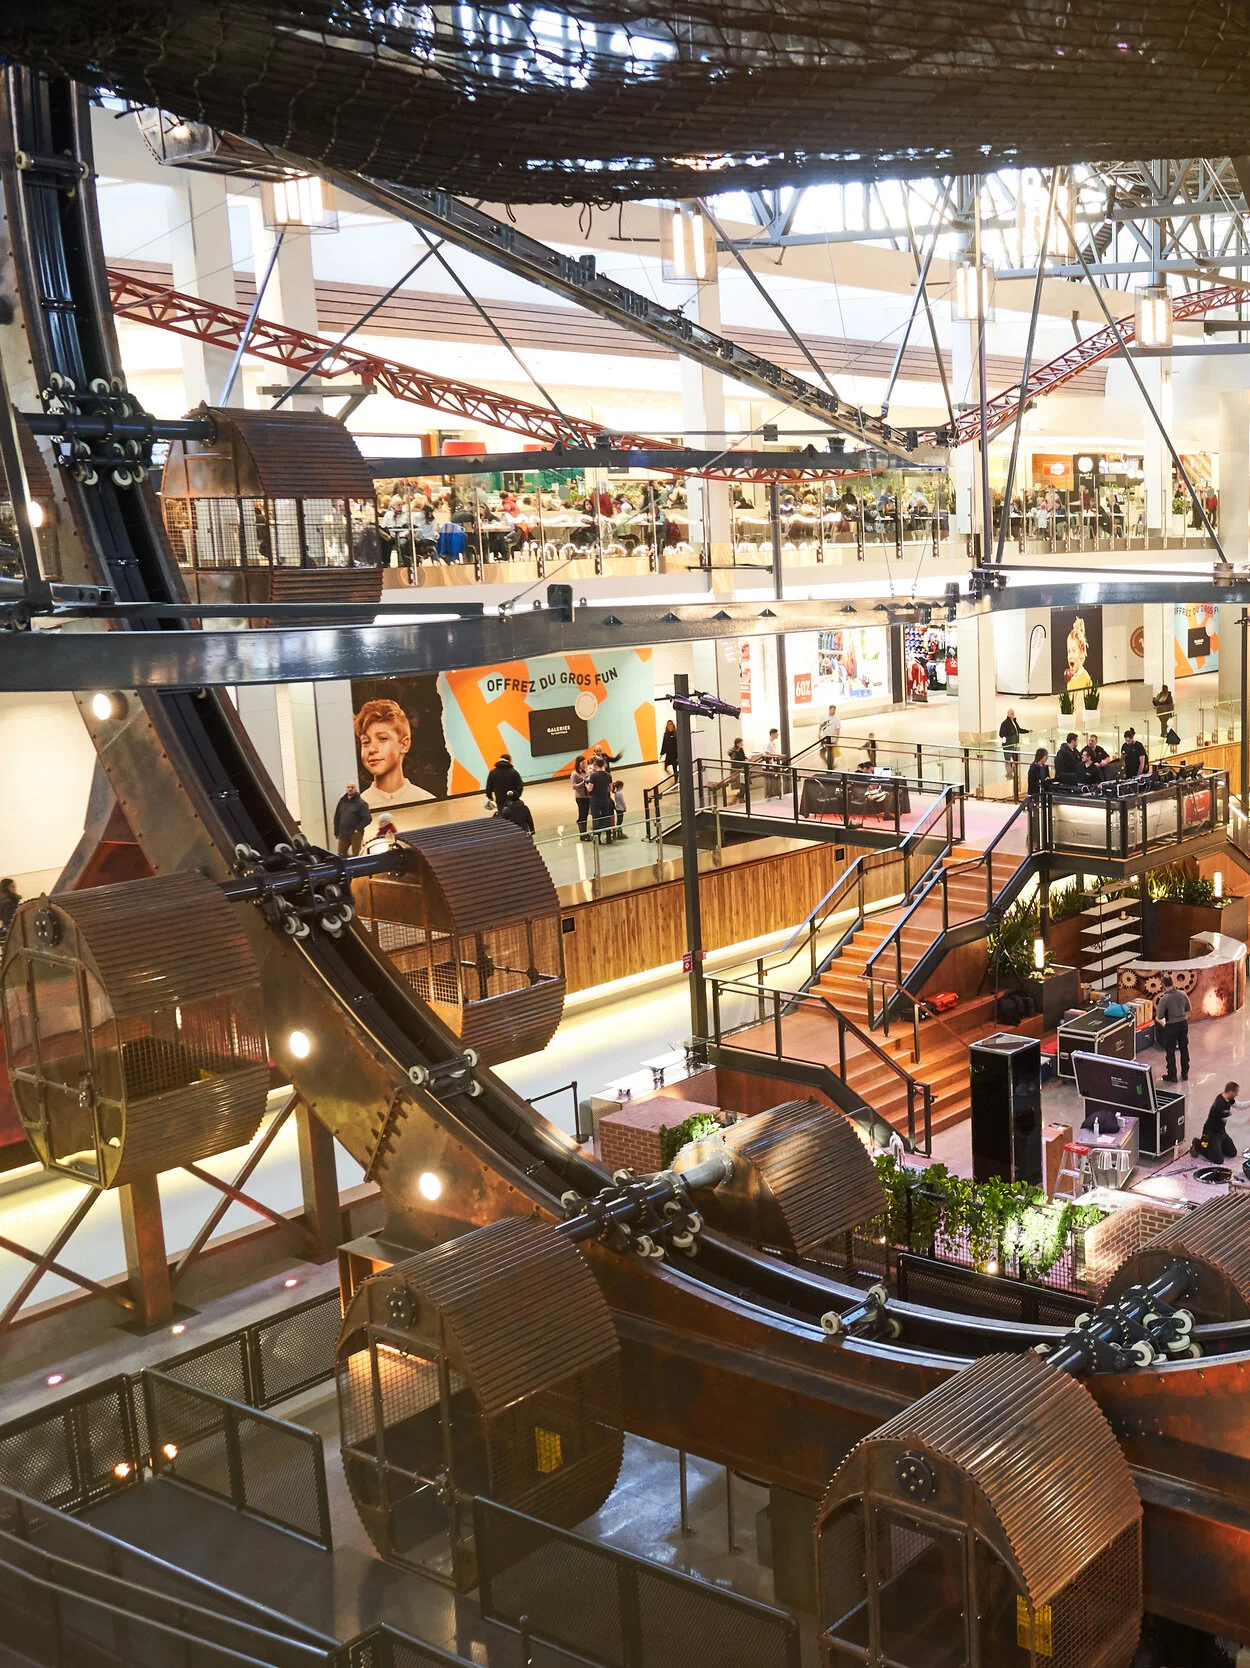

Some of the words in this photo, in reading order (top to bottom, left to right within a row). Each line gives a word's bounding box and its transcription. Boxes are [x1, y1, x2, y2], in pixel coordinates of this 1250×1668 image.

[487, 678, 536, 693] OFFREZ
[539, 673, 556, 690] DU
[560, 672, 591, 686] GROS
[595, 667, 618, 686] FUN
[796, 680, 811, 697] 60%
[547, 725, 570, 733] GALERIES
